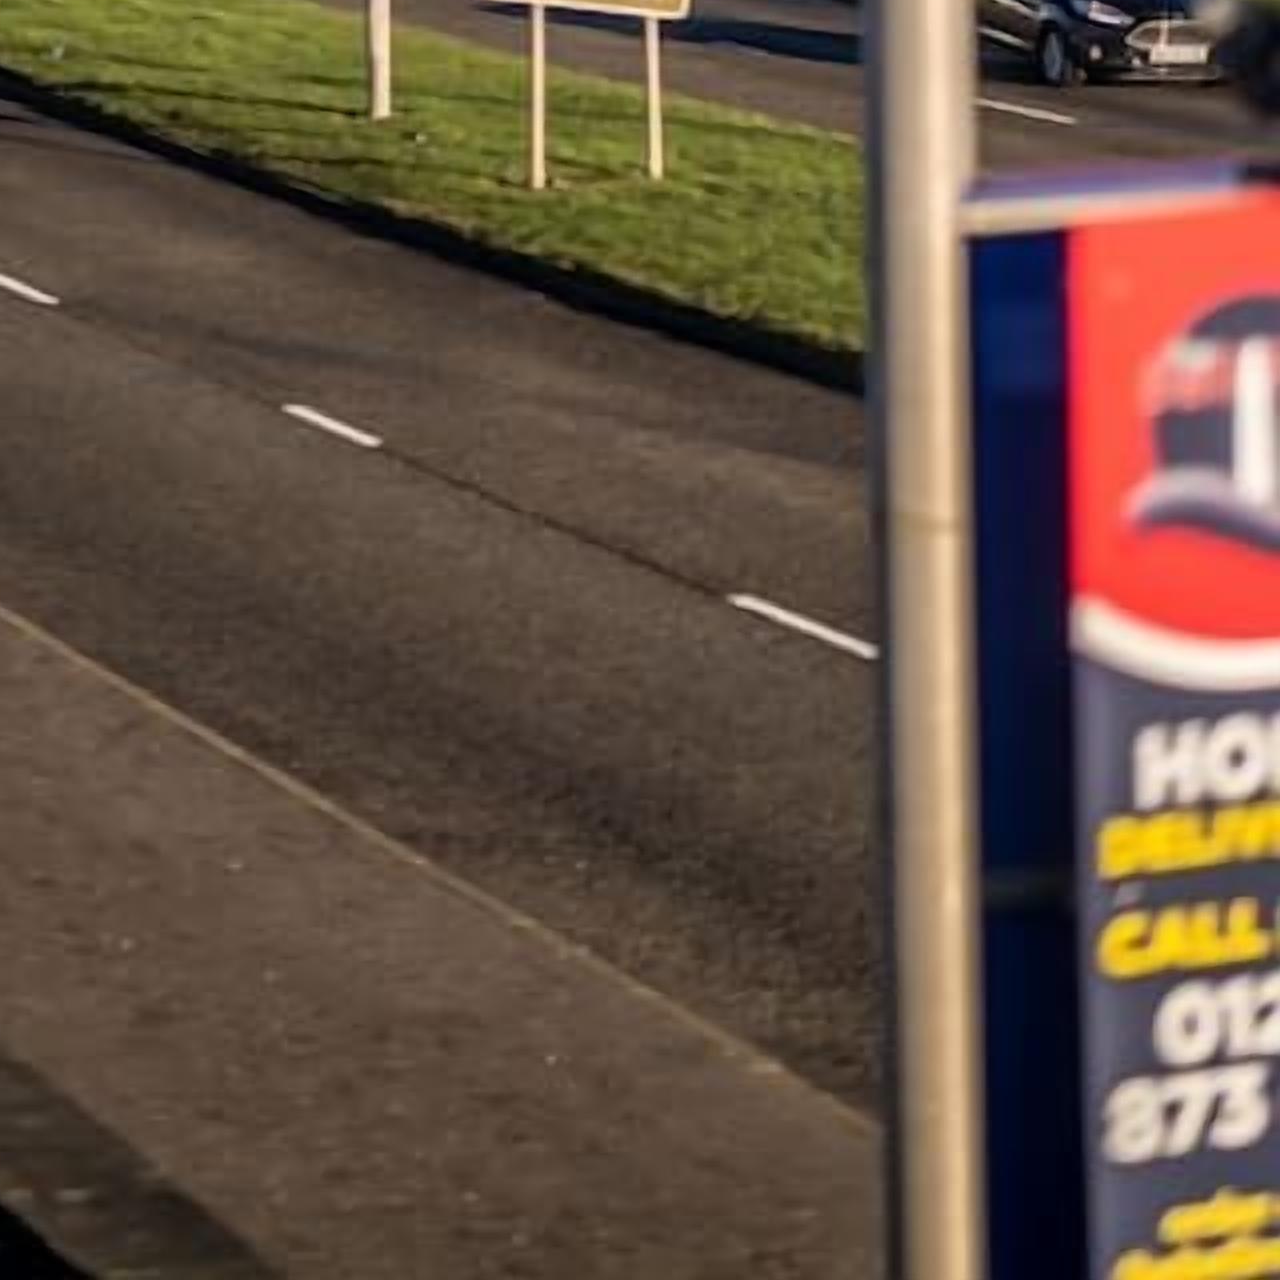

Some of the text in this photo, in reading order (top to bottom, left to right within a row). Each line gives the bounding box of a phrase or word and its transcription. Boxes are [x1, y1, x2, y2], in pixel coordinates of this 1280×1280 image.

[1134, 710, 1280, 810] HO
[1098, 897, 1270, 978] CALL
[1104, 1060, 1270, 1164] 873
